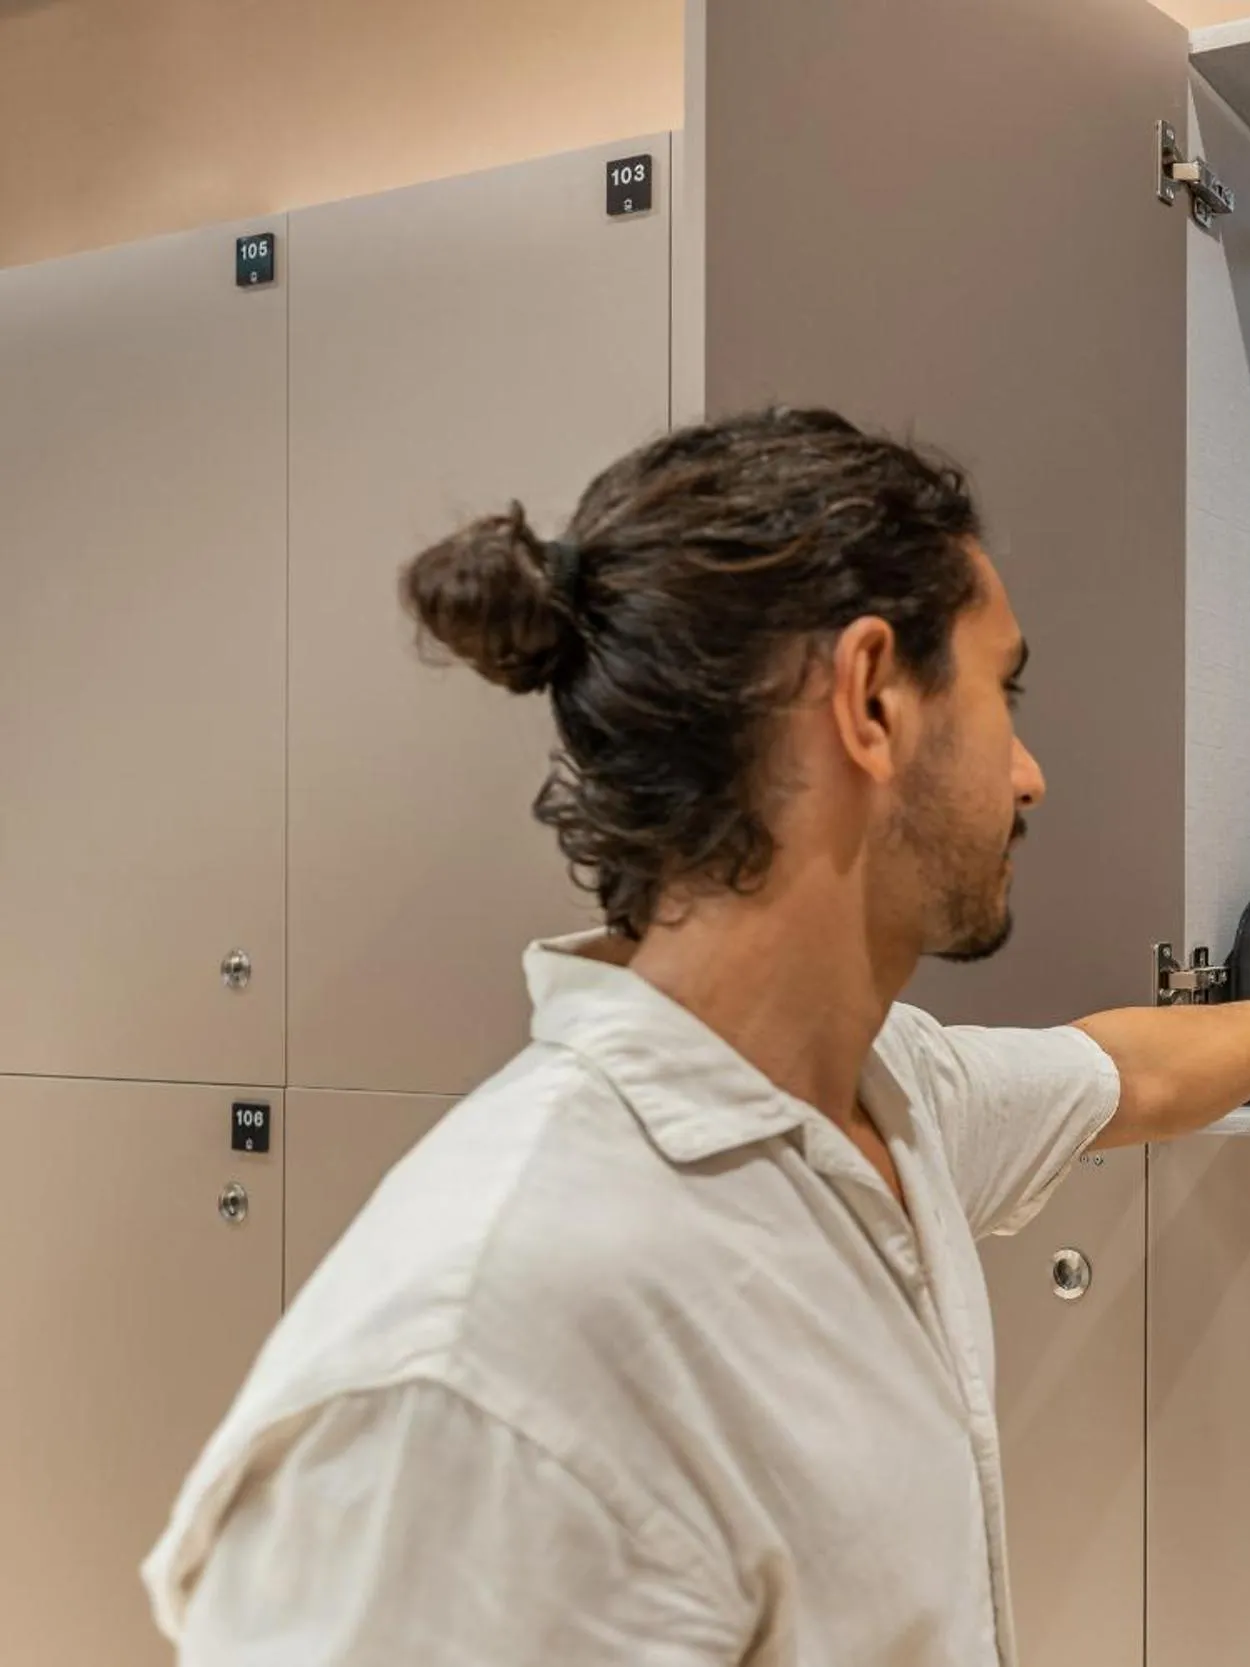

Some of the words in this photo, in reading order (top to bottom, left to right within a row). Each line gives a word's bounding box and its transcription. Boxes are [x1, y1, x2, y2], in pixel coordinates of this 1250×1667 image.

[611, 164, 645, 186] 103
[240, 240, 267, 260] 105
[236, 1109, 264, 1127] 106
